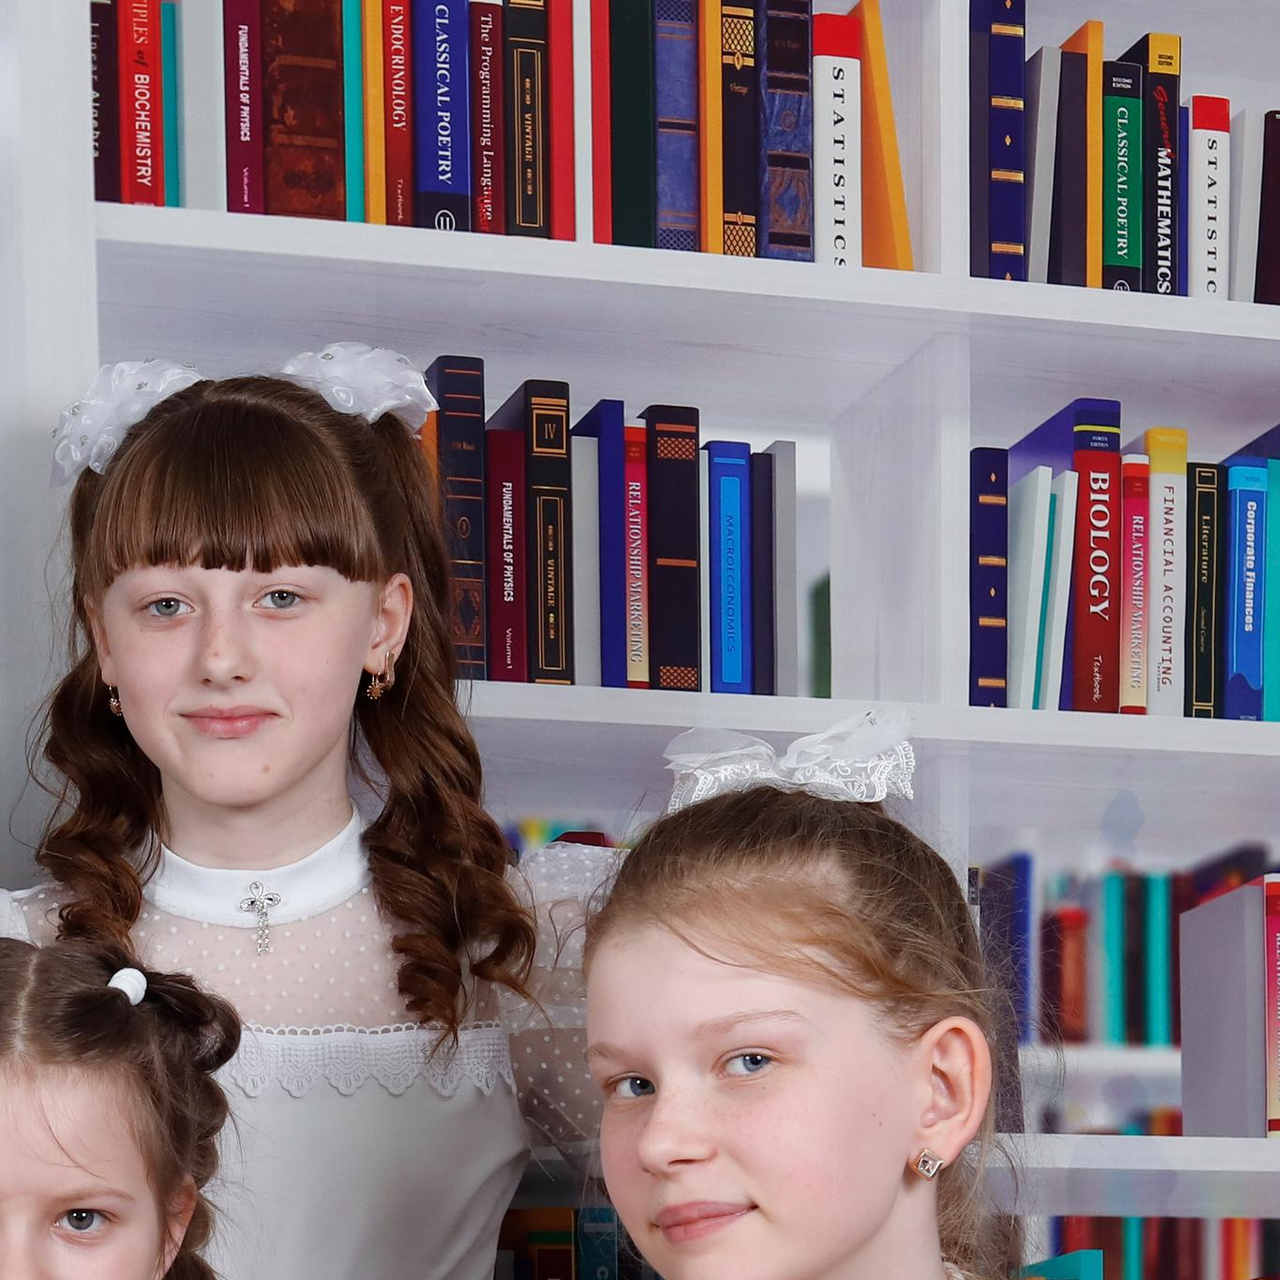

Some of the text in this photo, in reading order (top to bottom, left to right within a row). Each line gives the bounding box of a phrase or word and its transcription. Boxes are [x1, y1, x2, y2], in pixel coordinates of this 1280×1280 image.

[134, 50, 149, 68] of
[238, 25, 251, 142] FUNDAMENTALS OF PHYSICS
[390, 4, 407, 132] ENDOCRINOLOGY
[480, 13, 494, 42] The
[134, 73, 152, 187] BIOCHEMISTRY
[434, 4, 452, 186] CLASSICAL POETRY
[478, 46, 495, 147] Programming
[524, 112, 533, 163] VINTAGE
[481, 150, 495, 221] Language
[1116, 107, 1129, 260] CLASSICAL POETRY
[1156, 147, 1172, 294] MATHEMATICS
[1206, 138, 1218, 294] STATISTIC
[544, 423, 556, 440] IV
[502, 482, 514, 602] FUNDAMENTALS OF PHYSICS
[547, 559, 556, 607] VINTAGE
[628, 481, 644, 663] RELATIONSHIP MARKETING
[725, 515, 736, 653] MACROECONOMICS
[1088, 470, 1111, 622] BIOLOGY
[1160, 484, 1175, 687] FINANCIAL ACCOUNTING
[1200, 514, 1212, 583] Literature
[1243, 500, 1258, 632] Corporate Finances
[505, 627, 513, 664] Volume
[1130, 514, 1145, 689] RELATIONSHIP MARKETING
[1092, 654, 1103, 703] Textbook
